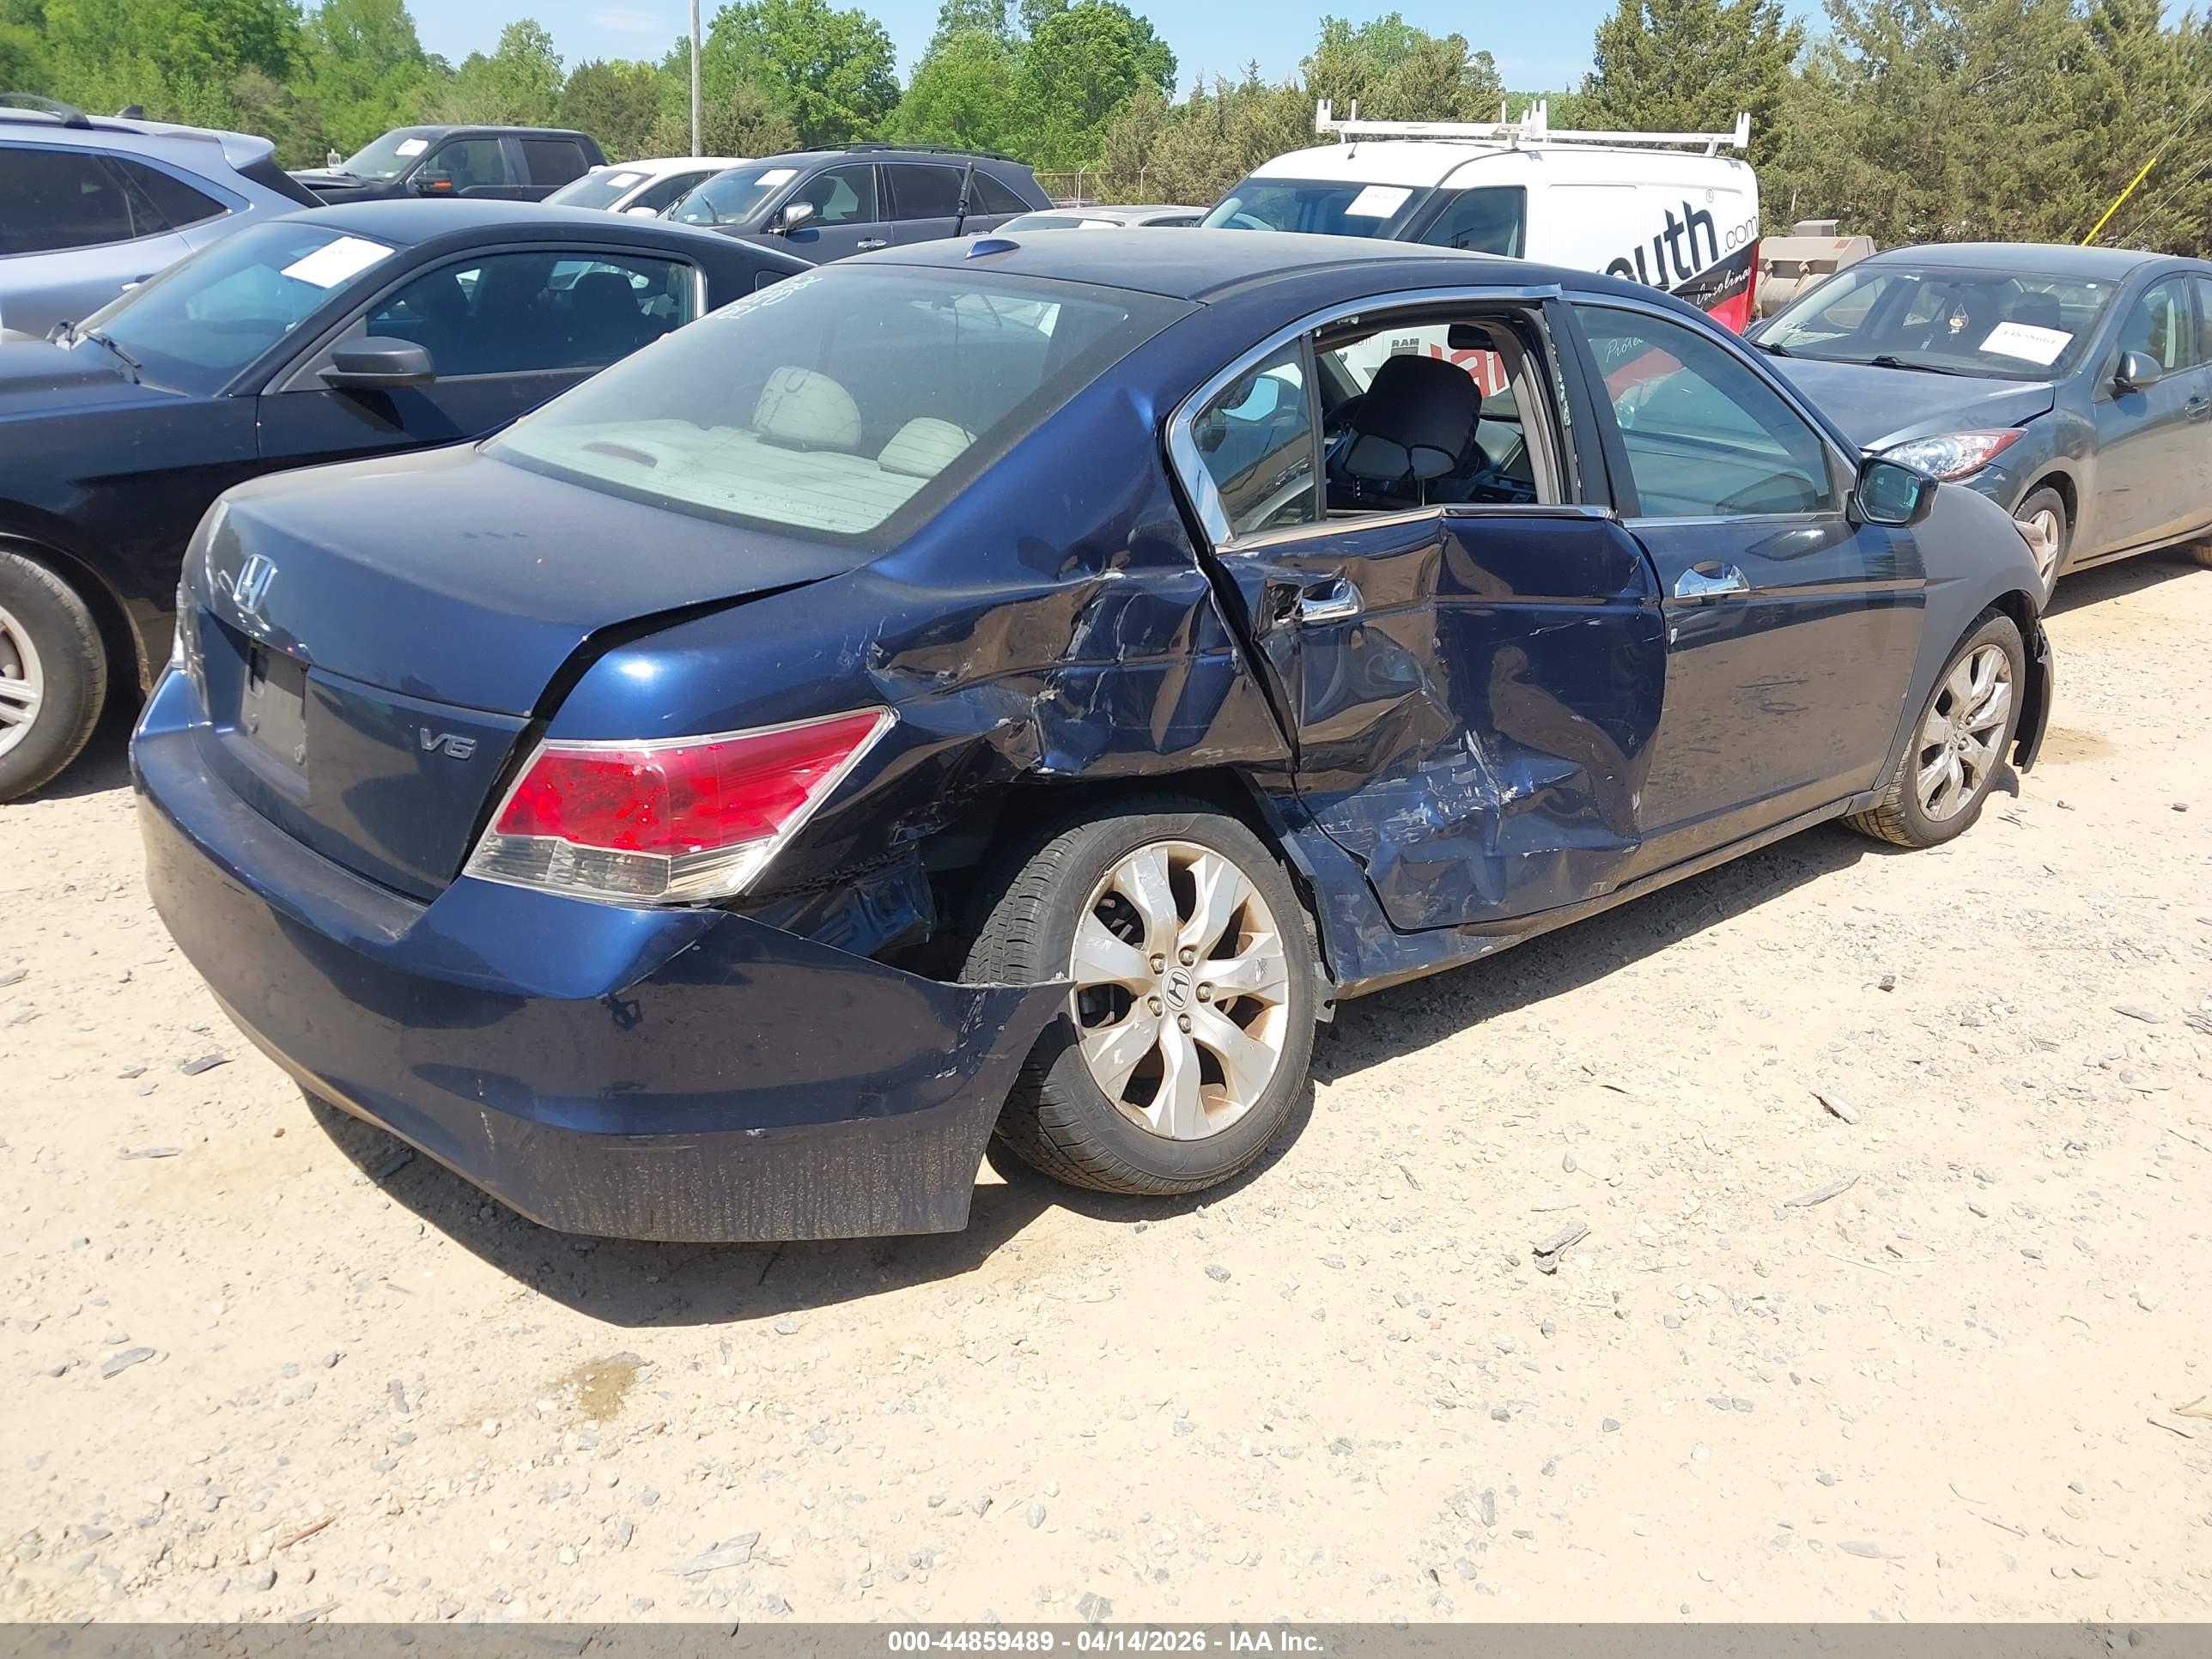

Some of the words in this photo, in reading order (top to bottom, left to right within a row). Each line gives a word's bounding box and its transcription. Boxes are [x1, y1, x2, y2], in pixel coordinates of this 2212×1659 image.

[1725, 216, 1759, 252] .com
[1392, 338, 1419, 348] RAM
[420, 728, 477, 760] V6
